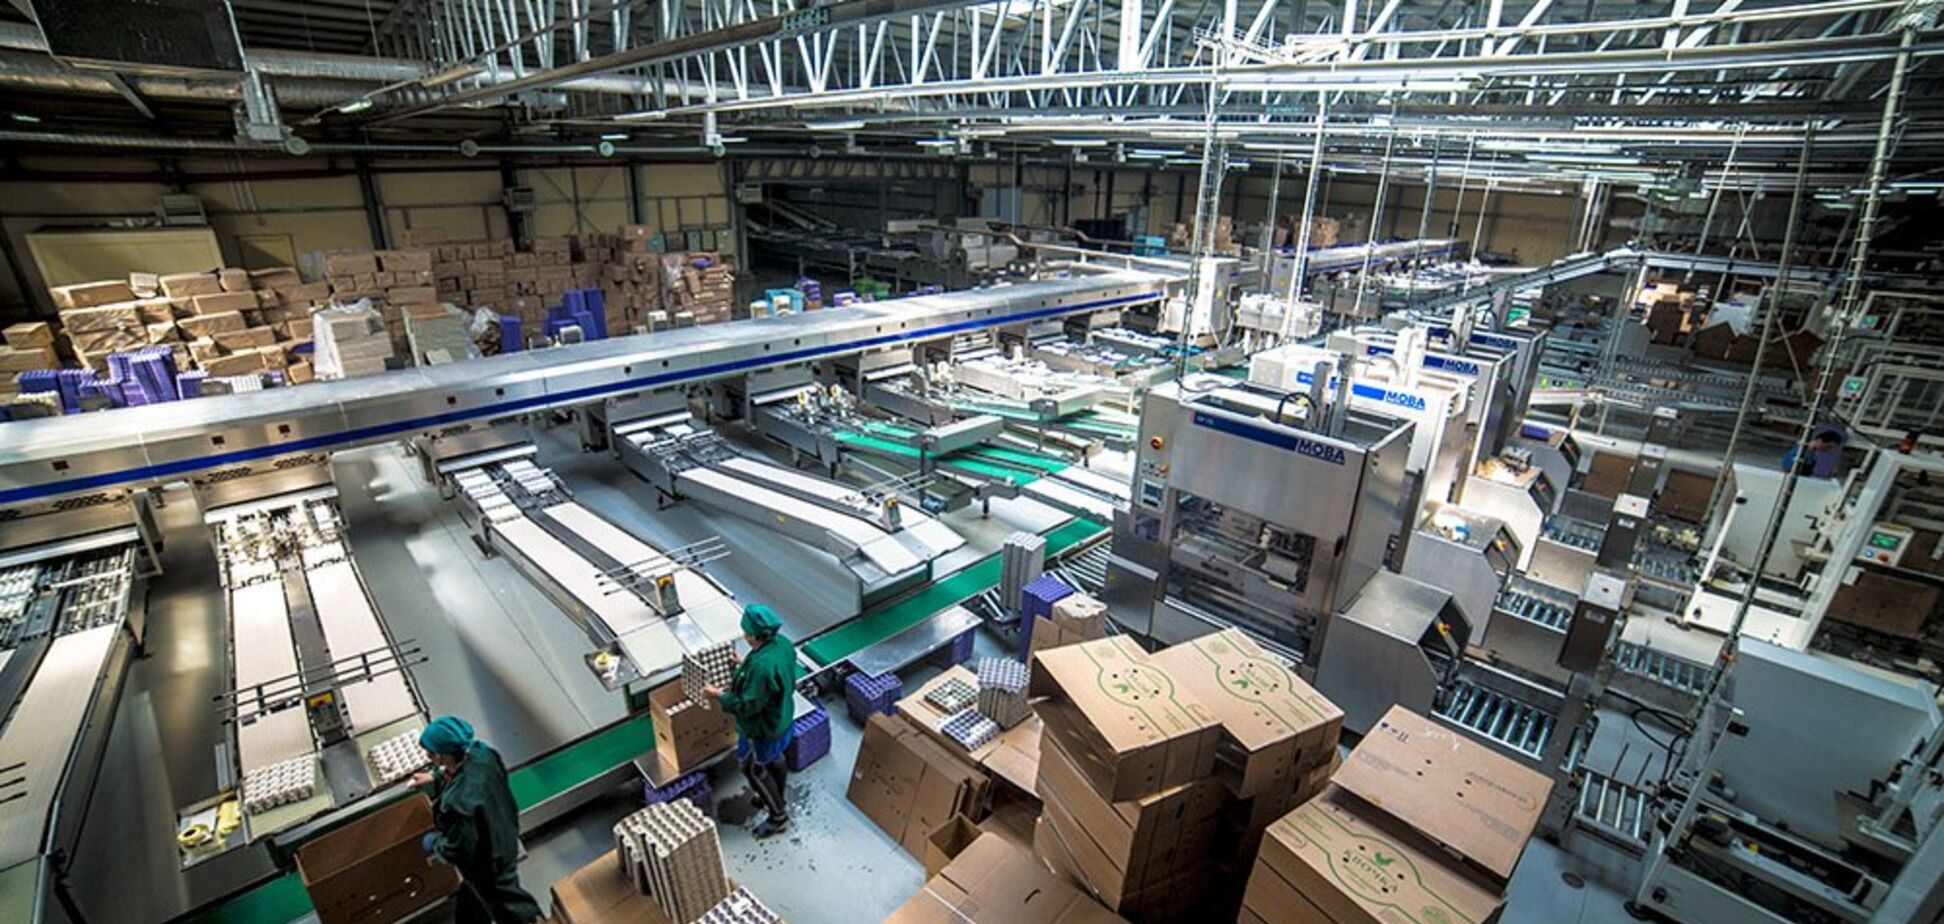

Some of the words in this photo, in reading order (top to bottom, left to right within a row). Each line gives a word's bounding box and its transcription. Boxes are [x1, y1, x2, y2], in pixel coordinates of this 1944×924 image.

[1444, 359, 1479, 375] MOBA
[1386, 391, 1425, 410] MOBA
[1298, 439, 1346, 465] MOBA
